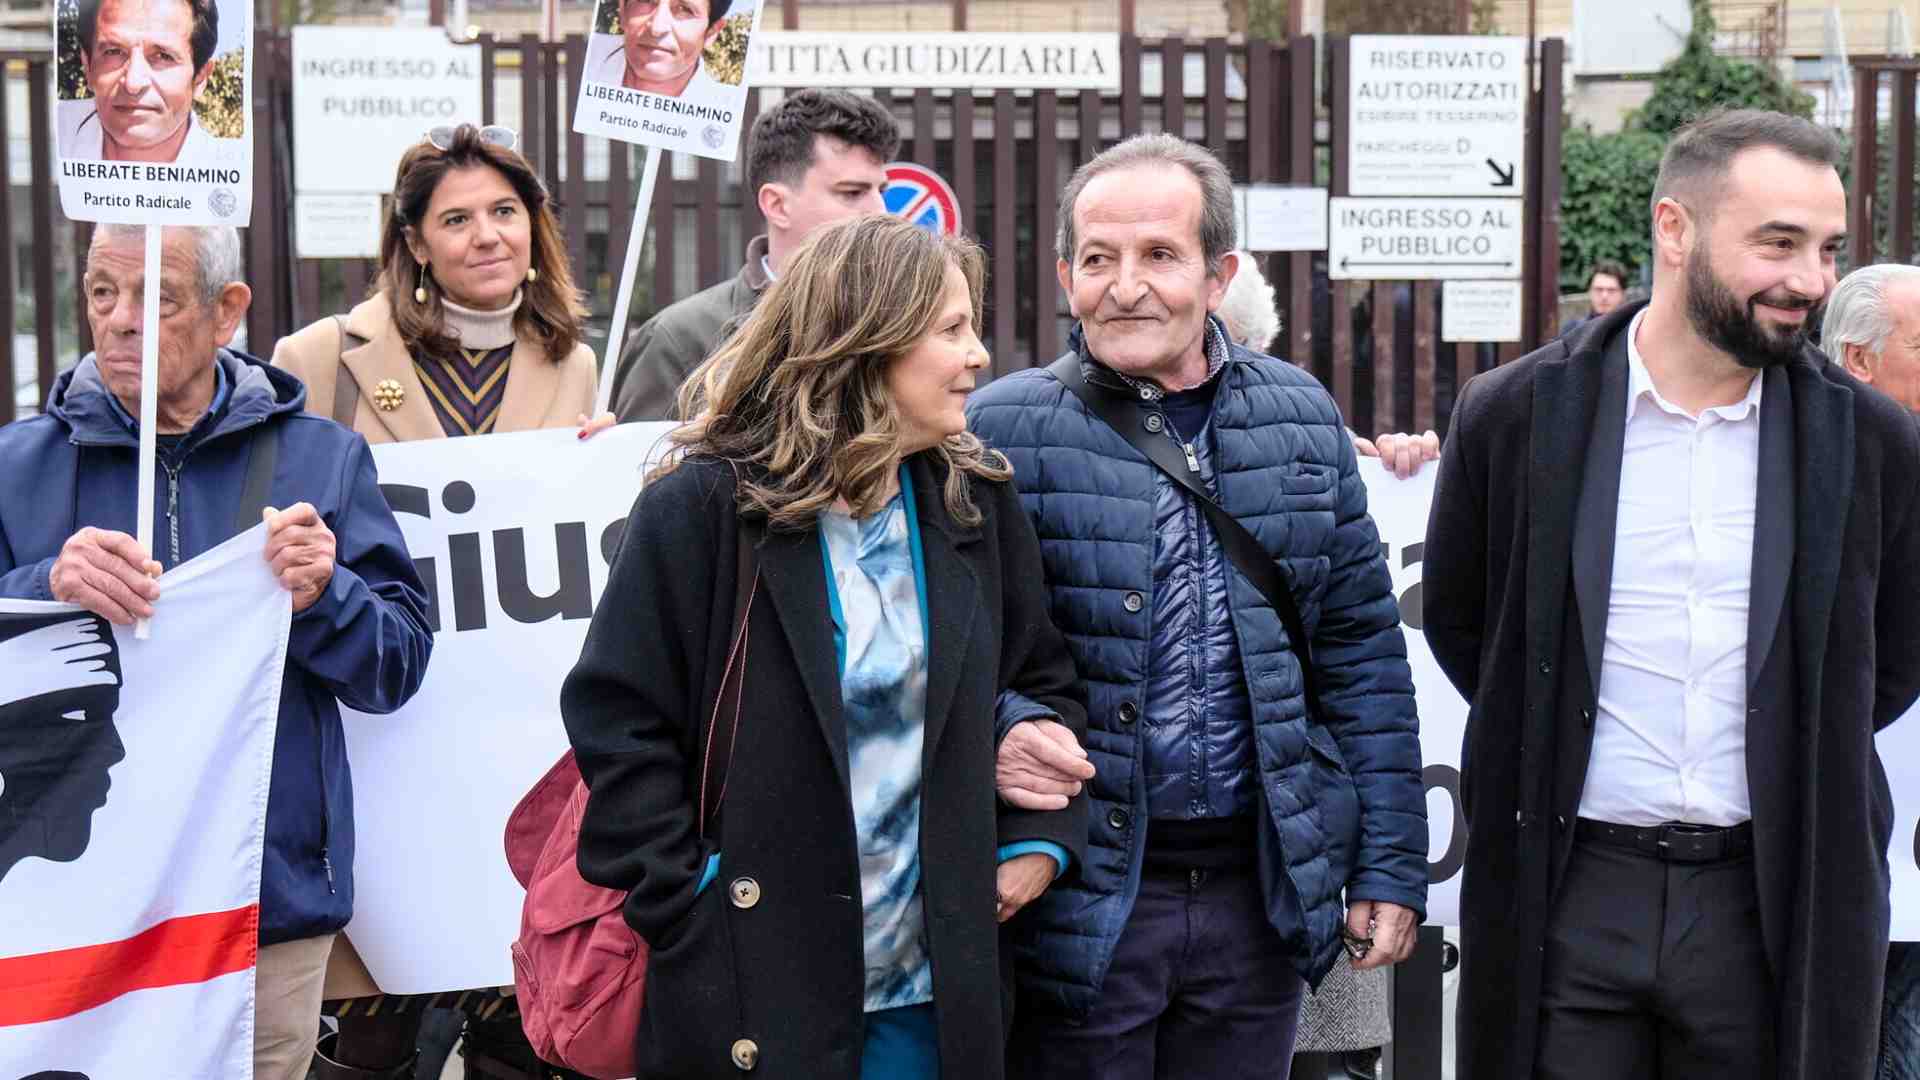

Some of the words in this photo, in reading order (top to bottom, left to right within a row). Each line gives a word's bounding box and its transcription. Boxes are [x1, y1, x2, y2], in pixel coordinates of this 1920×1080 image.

[302, 57, 436, 80] INGRESSO
[445, 58, 473, 79] AL
[757, 45, 852, 74] ITTA
[862, 45, 1106, 75] GIUDIZIARIA
[1370, 51, 1506, 70] RISERVATO
[1358, 82, 1518, 101] AUTORIZZATI
[322, 97, 457, 118] PUBBLICO
[586, 84, 651, 109] LIBERATE
[653, 97, 733, 124] BENIAMINO
[599, 111, 639, 130] Partito
[641, 118, 689, 139] Radicale
[62, 161, 141, 181] LIBERATE
[145, 166, 241, 184] BENIAMINO
[83, 191, 131, 208] Partito
[135, 194, 192, 210] Radicale
[1341, 208, 1473, 229] INGRESSO
[1479, 208, 1512, 229] AL
[1360, 235, 1492, 256] PUBBLICO
